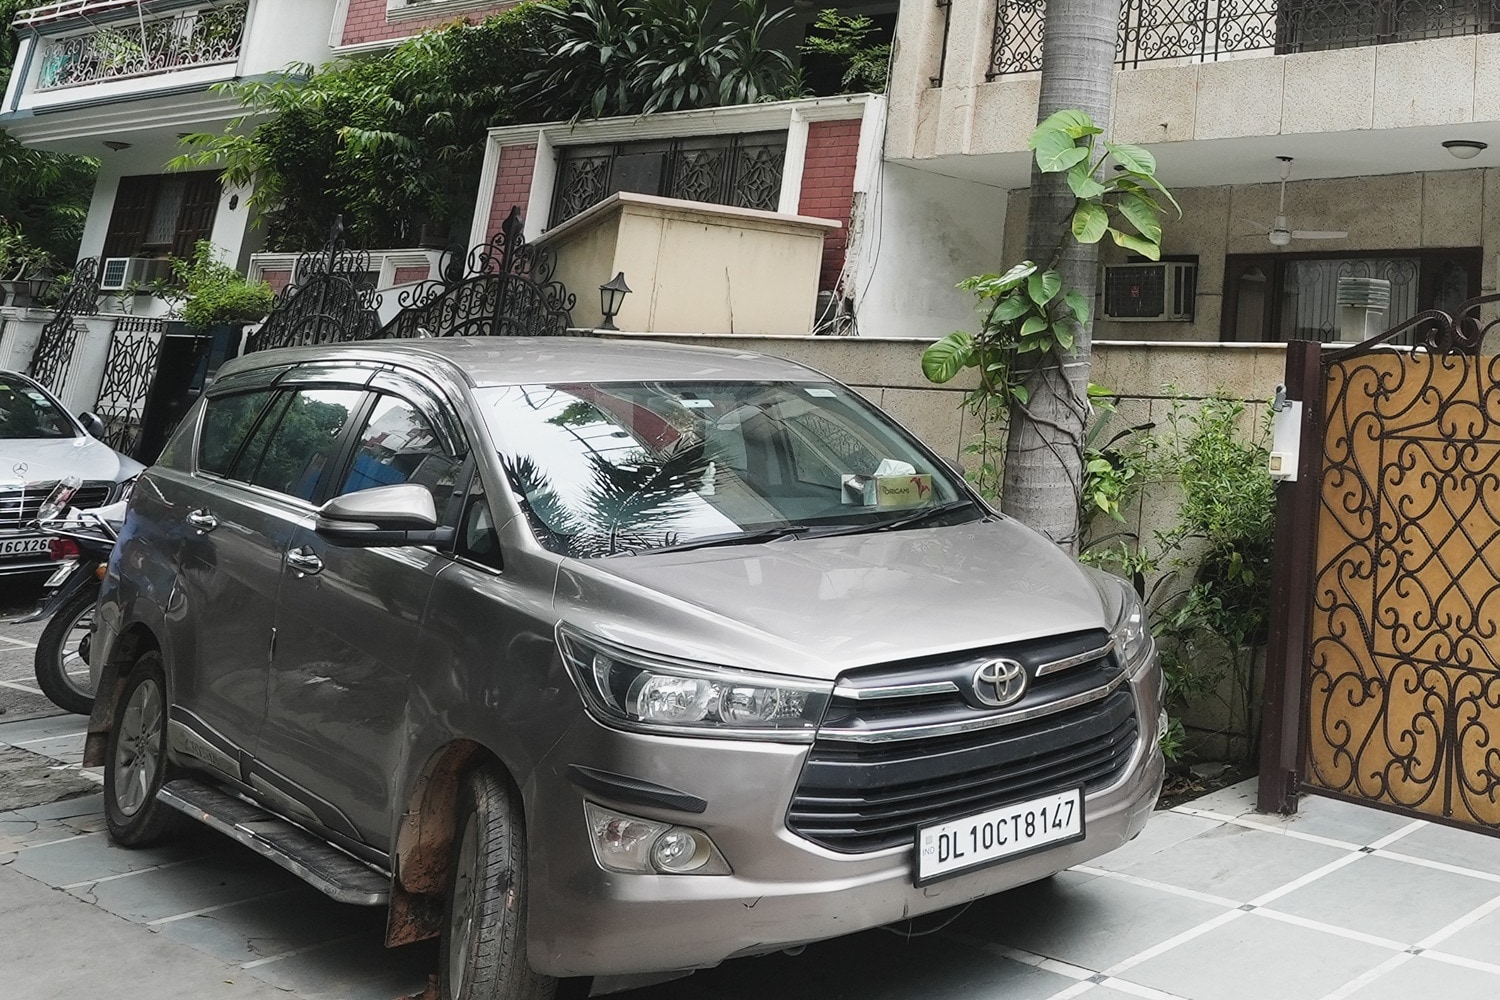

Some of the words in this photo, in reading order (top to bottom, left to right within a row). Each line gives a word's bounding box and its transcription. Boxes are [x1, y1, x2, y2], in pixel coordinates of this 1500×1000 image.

[0, 539, 52, 553] 16CX26
[938, 800, 1075, 863] DL10CT8147
[922, 846, 935, 856] IND
